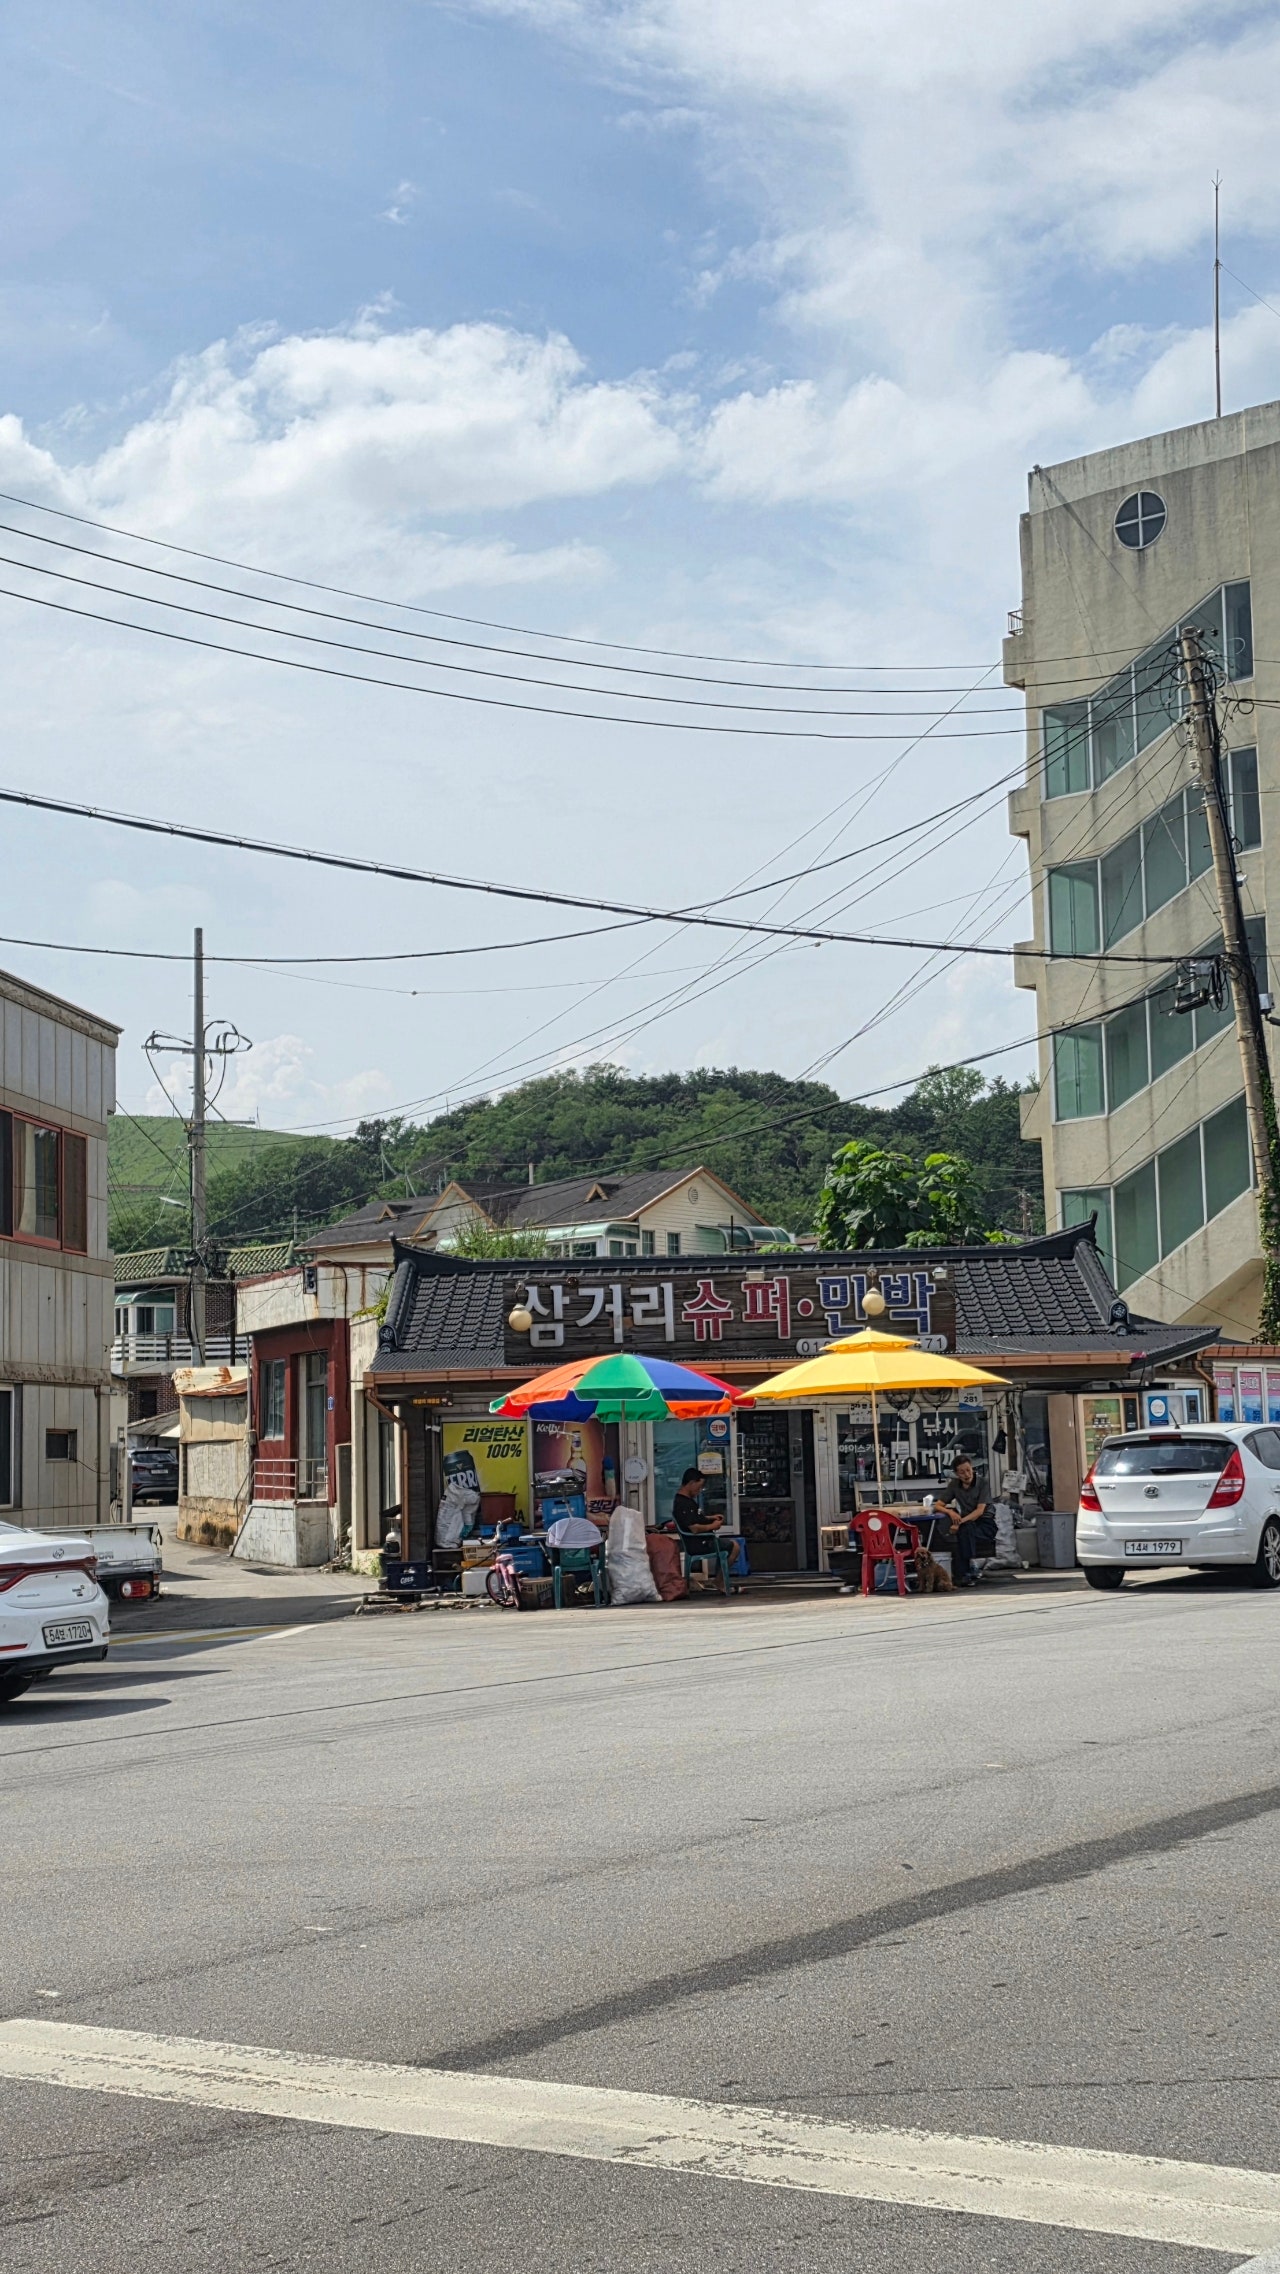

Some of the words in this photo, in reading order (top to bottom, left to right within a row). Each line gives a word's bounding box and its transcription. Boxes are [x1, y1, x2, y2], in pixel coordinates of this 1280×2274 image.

[463, 1425, 524, 1442] 리얼탄산
[536, 1423, 560, 1433] Kelly
[487, 1443, 522, 1458] 100%
[1153, 1542, 1176, 1552] 1979
[68, 1625, 88, 1639] 1720
